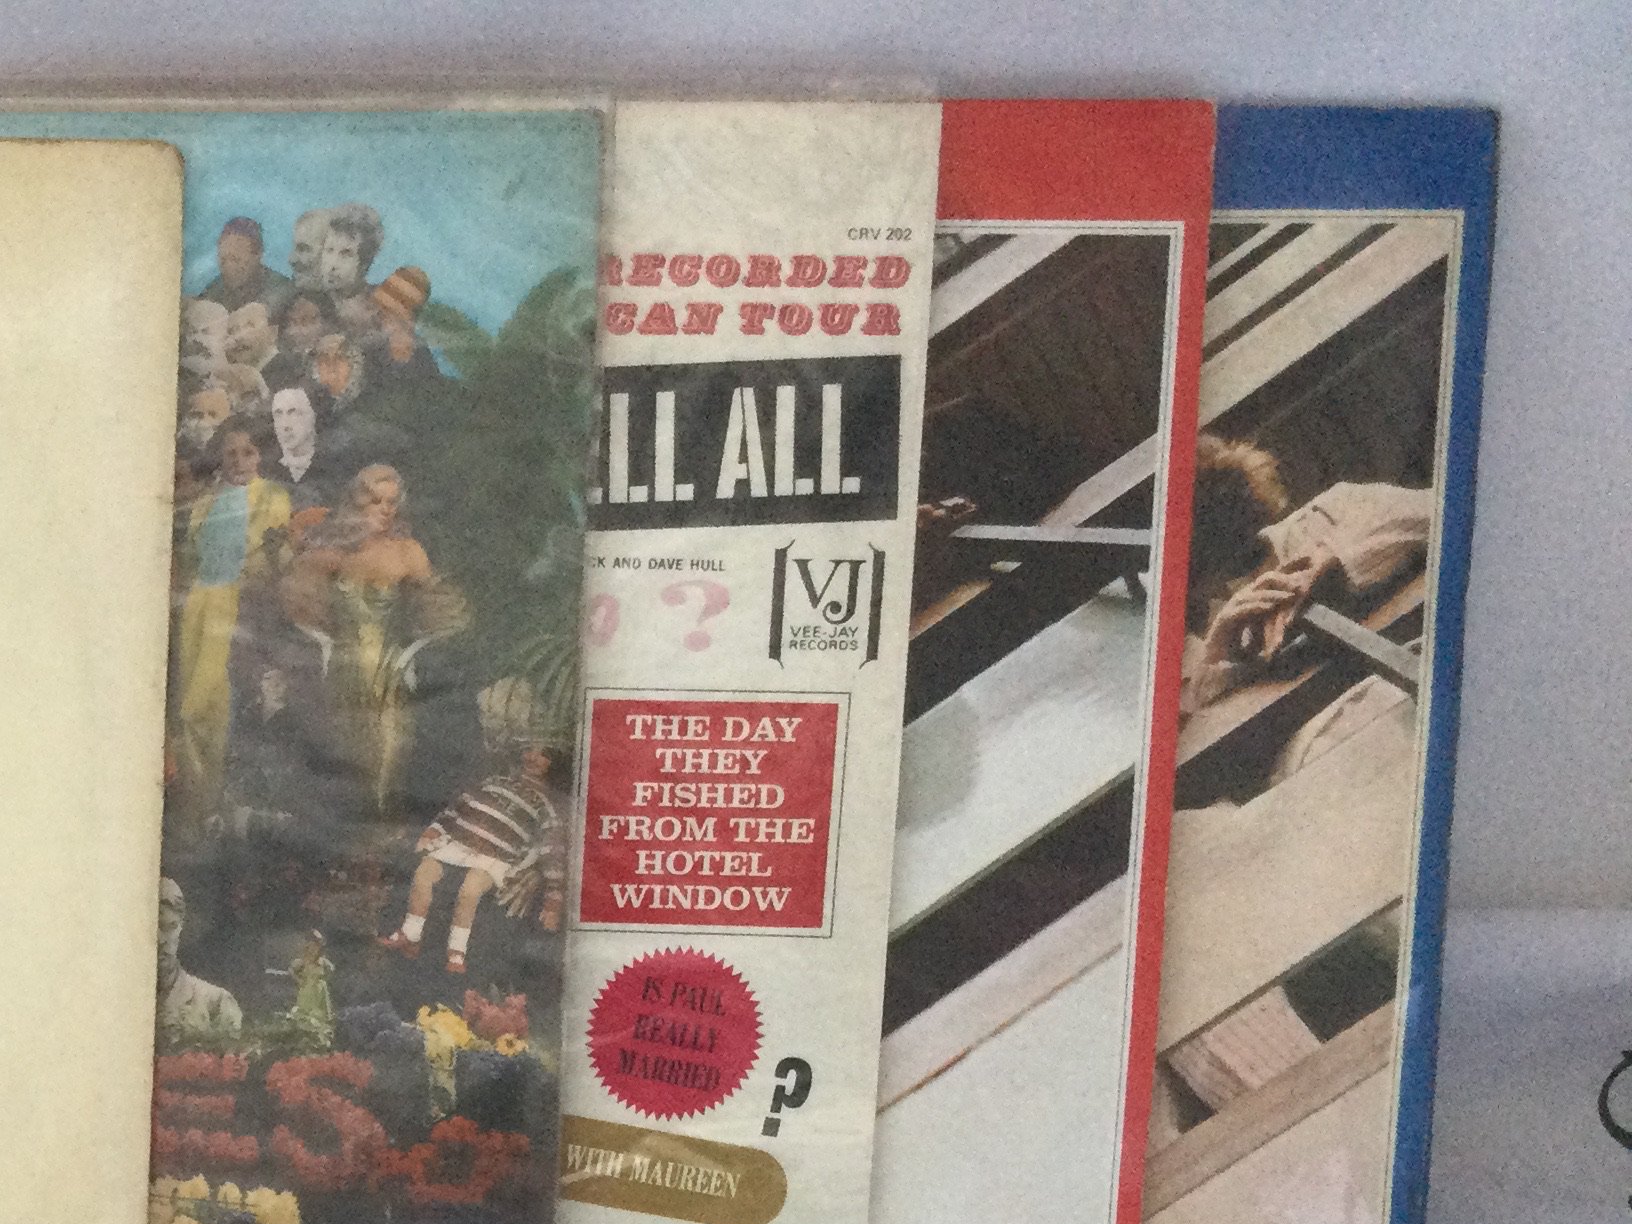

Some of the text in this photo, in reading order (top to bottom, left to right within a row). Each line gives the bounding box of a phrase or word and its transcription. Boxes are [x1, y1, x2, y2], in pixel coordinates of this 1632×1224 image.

[848, 228, 912, 241] CRV 202
[604, 302, 902, 336] CAN TOUR
[715, 383, 861, 499] ALL
[612, 557, 642, 570] AND
[647, 558, 684, 571] DAVE
[690, 559, 726, 572] HULL
[791, 558, 867, 625] VJ
[789, 639, 859, 651] RECORDS
[790, 626, 859, 638] VEE-JAY
[626, 714, 803, 742] THE DAY
[655, 748, 768, 774] THEY
[632, 782, 785, 808] FISHED
[598, 815, 816, 844] FROM THE
[635, 850, 772, 877] HOTEL
[610, 883, 792, 912] WINDOW
[642, 975, 726, 1016] IS PAUL
[632, 1014, 722, 1053] REALLY
[618, 1048, 721, 1090] MARRIED
[568, 1143, 741, 1199] WITH MAUREEN
